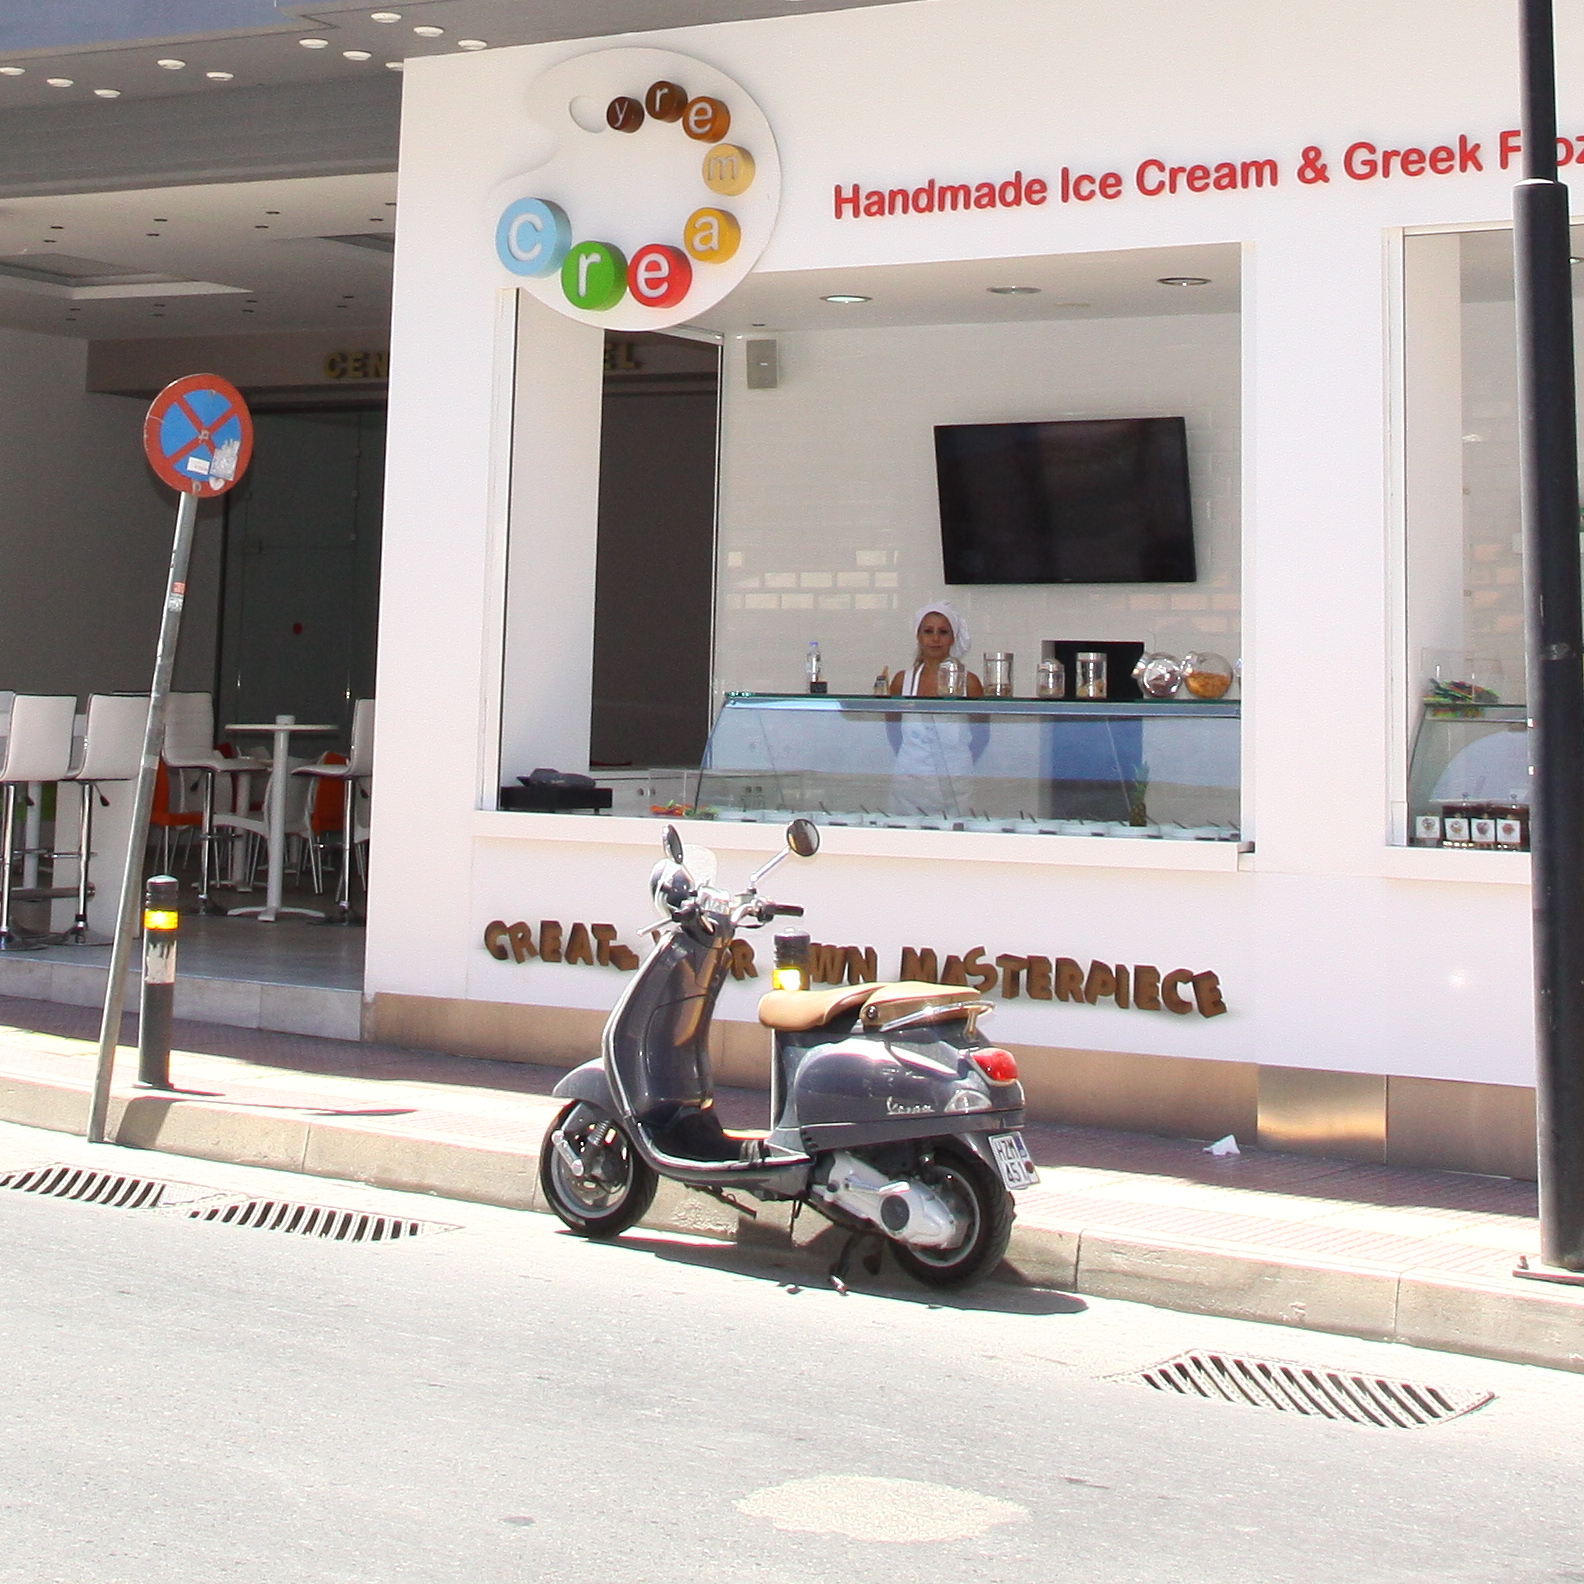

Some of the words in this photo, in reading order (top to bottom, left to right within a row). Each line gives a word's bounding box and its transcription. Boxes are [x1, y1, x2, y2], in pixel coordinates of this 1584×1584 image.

[834, 170, 1048, 220] Handmade
[1060, 166, 1123, 203] Ice
[1136, 158, 1279, 196] Cream
[1297, 145, 1330, 184] &
[1343, 134, 1484, 181] Greek
[900, 945, 1228, 1019] MASTERPIECE
